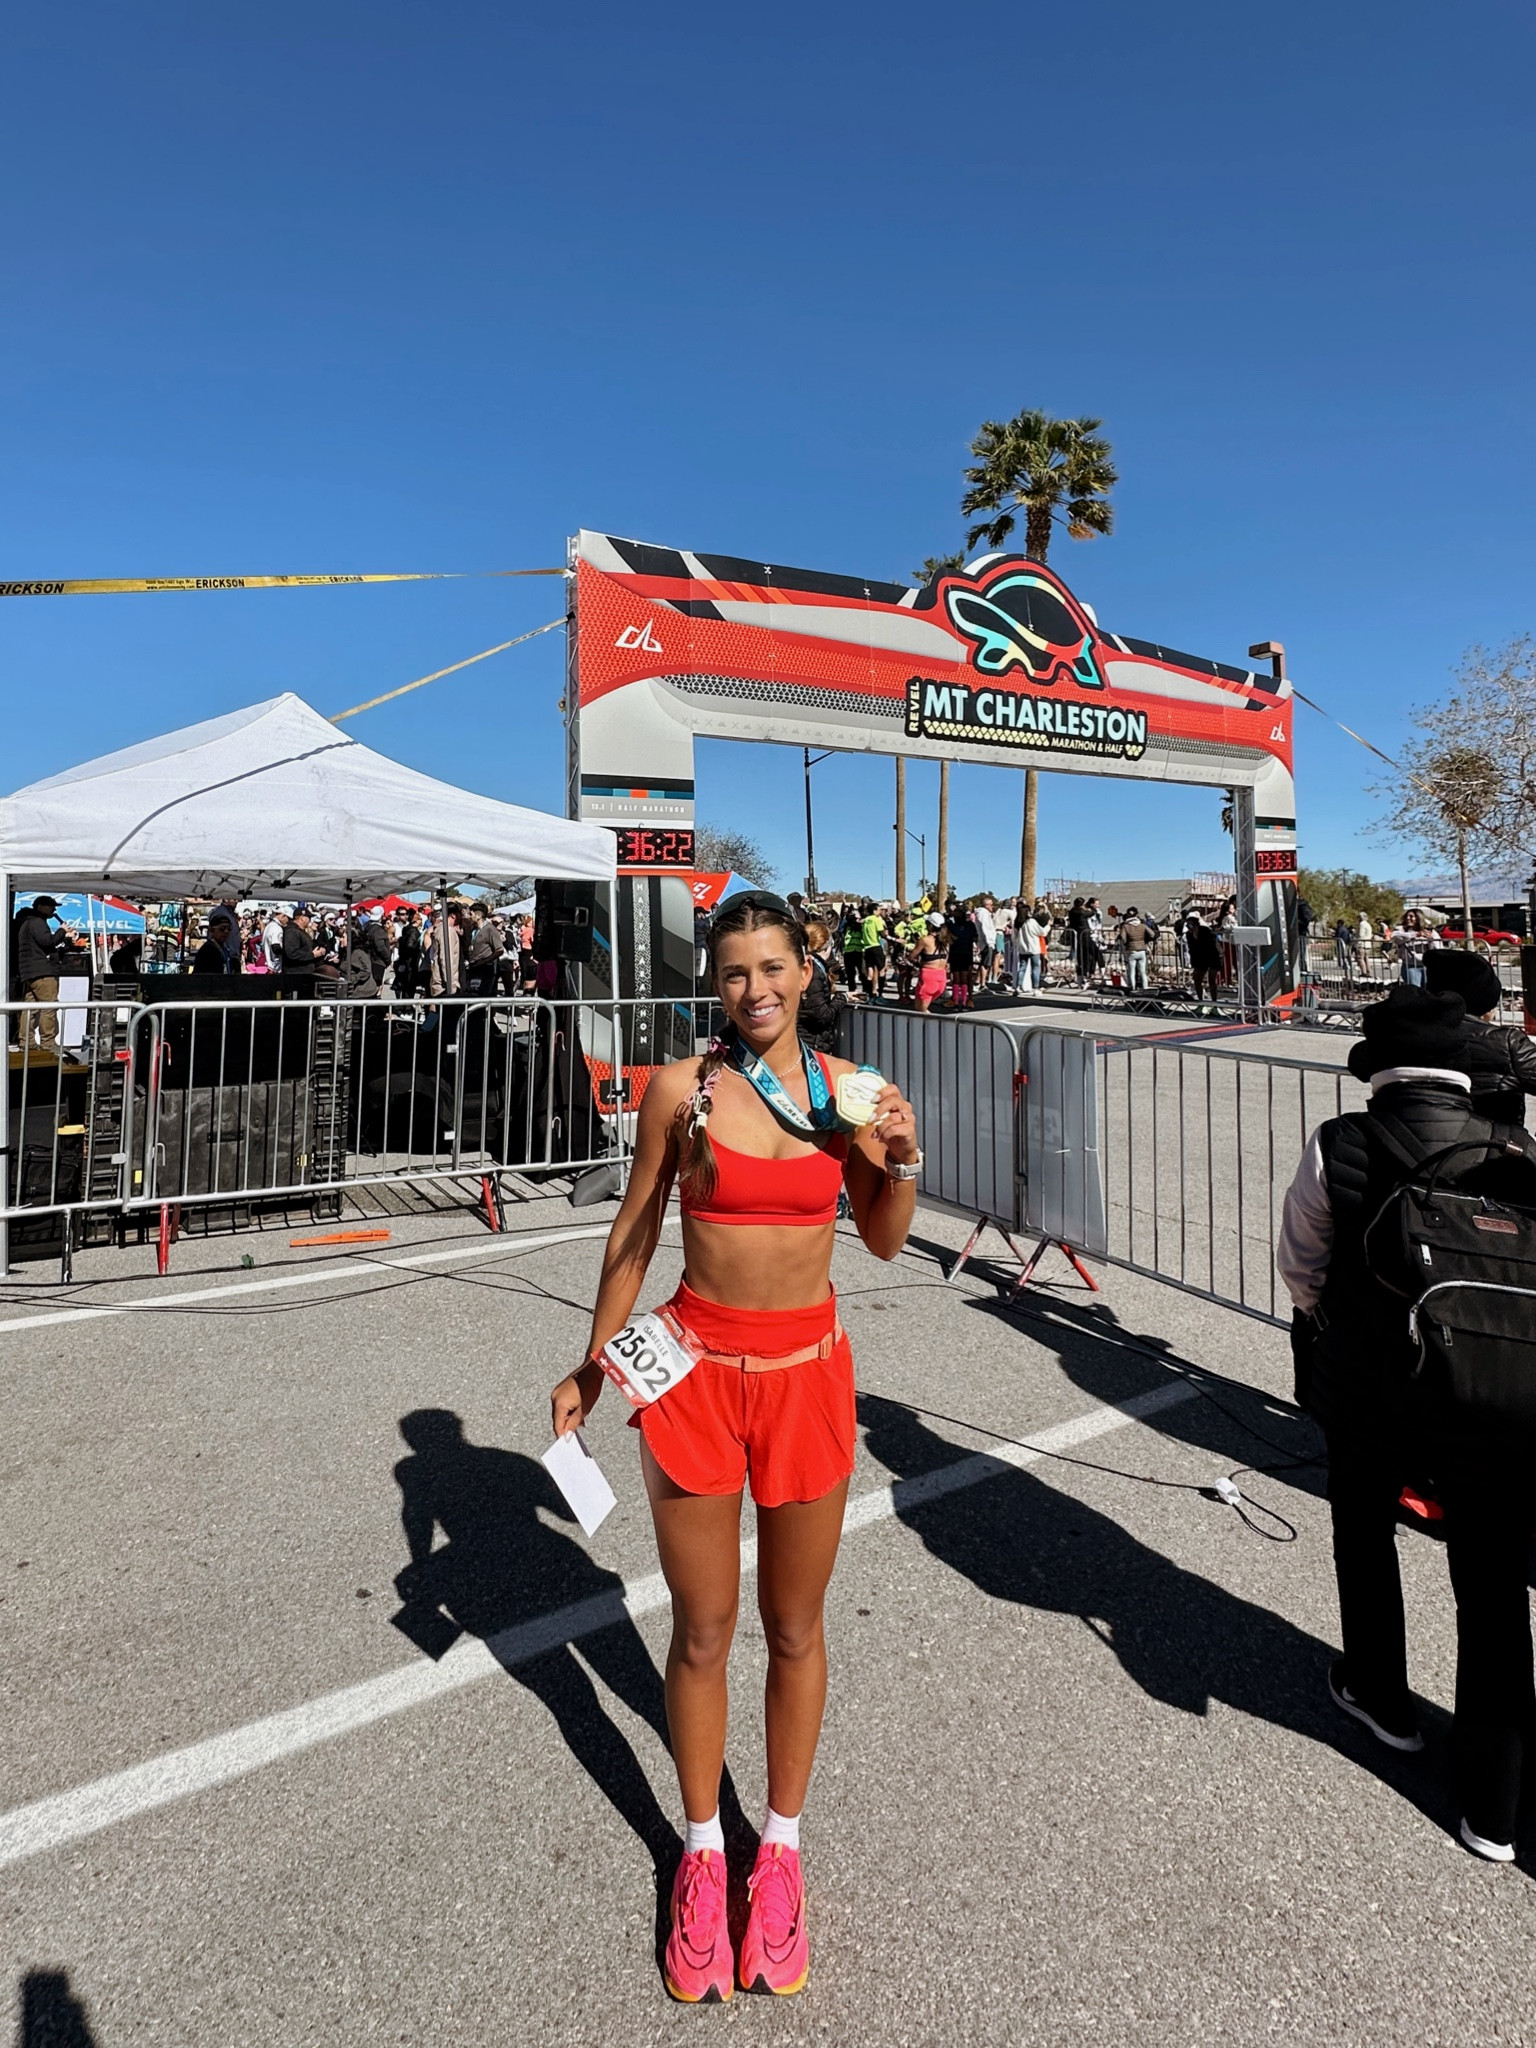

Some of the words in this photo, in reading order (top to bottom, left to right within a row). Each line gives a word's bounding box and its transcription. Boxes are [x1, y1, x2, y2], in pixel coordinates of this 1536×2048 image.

[196, 578, 245, 589] ERICKSON
[909, 682, 920, 732] REVEL
[924, 685, 968, 721] MT
[976, 692, 1146, 743] CHARLESTON
[1051, 736, 1098, 752] MARATHON
[1097, 743, 1104, 752] &
[1105, 744, 1124, 755] HALF
[642, 805, 685, 813] MARATHON
[87, 920, 132, 929] REVEL
[787, 1109, 808, 1127] REVEL
[643, 1325, 669, 1357] ISABELLE
[611, 1327, 671, 1394] 2502
